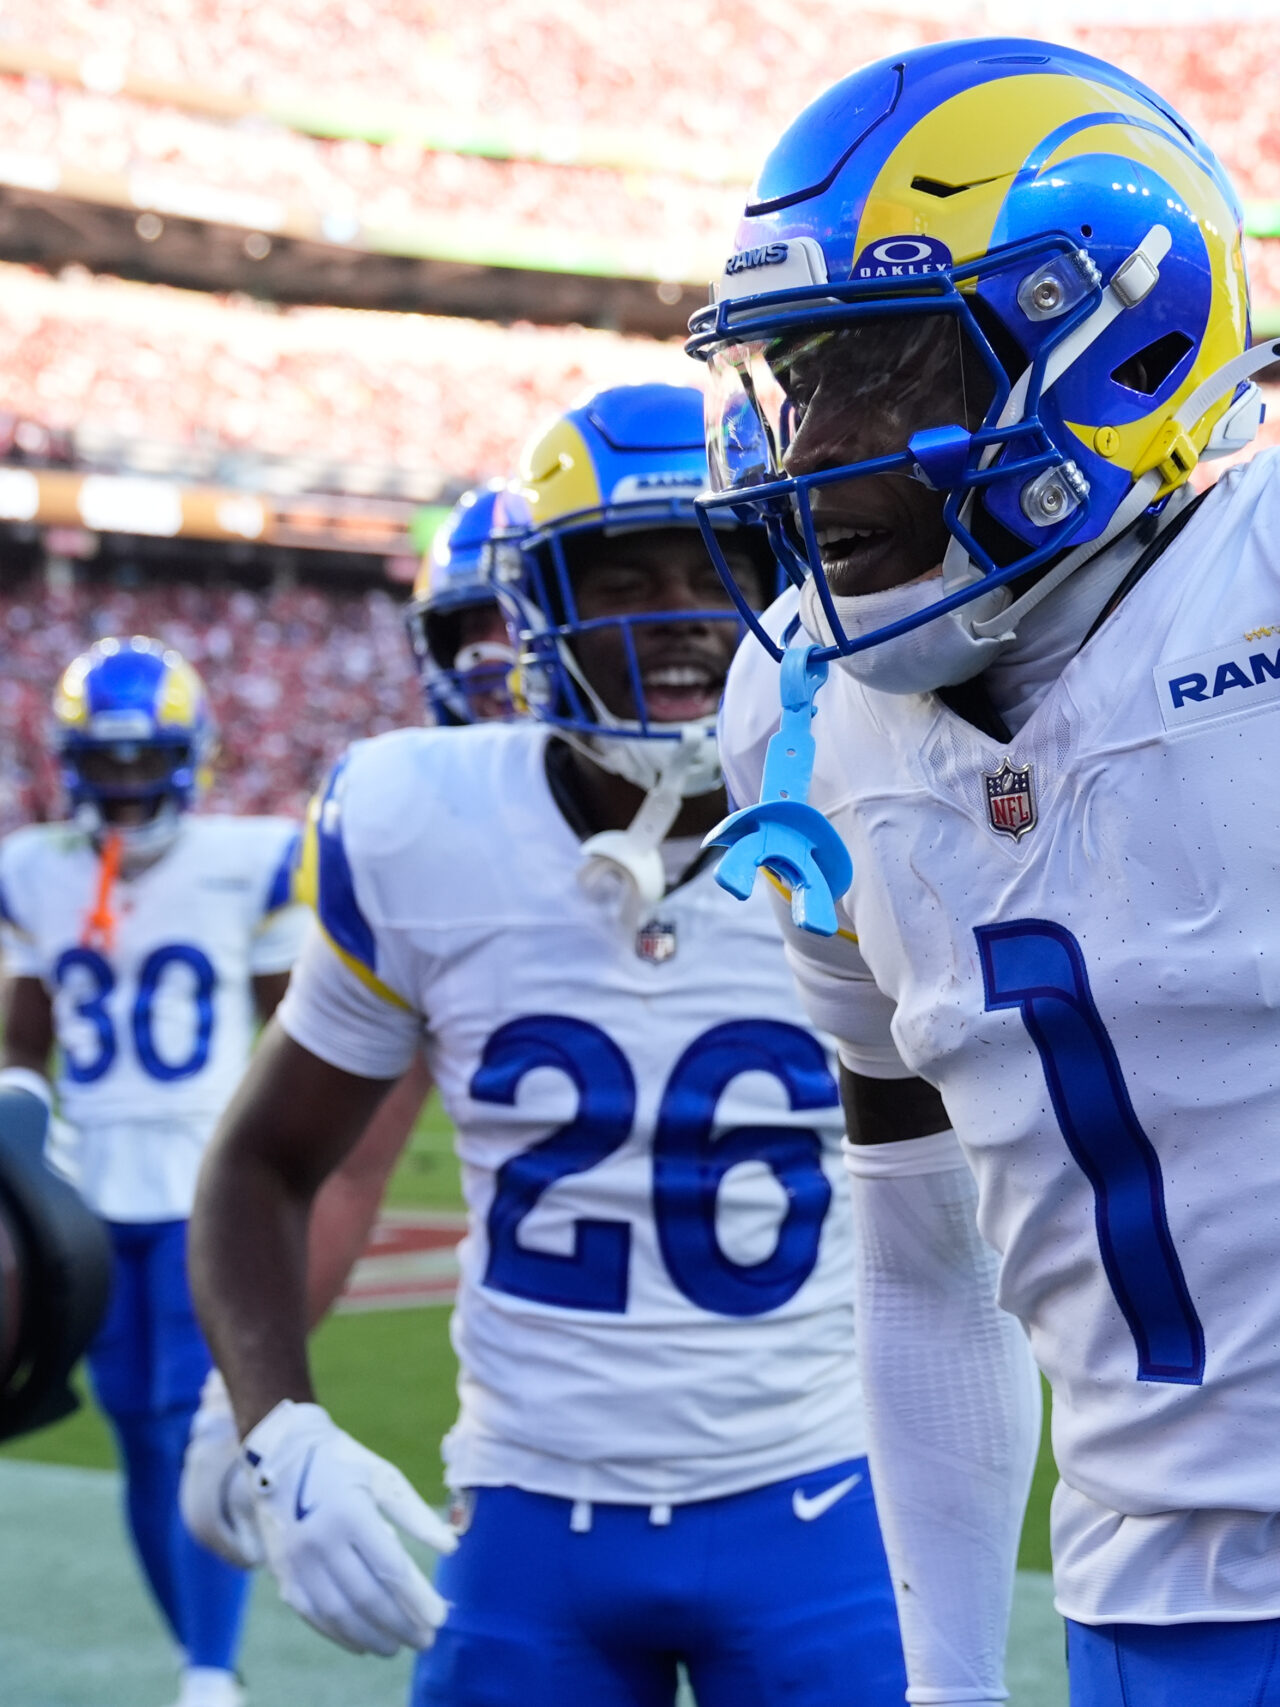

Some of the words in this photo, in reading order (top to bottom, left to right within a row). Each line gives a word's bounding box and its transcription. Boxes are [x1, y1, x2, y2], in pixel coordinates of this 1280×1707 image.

[725, 243, 788, 275] RAMS
[860, 263, 948, 278] OAKLEY
[991, 795, 1029, 828] NFL
[54, 944, 217, 1083] 30
[469, 1014, 840, 1316] 26
[973, 918, 1205, 1385] 1
